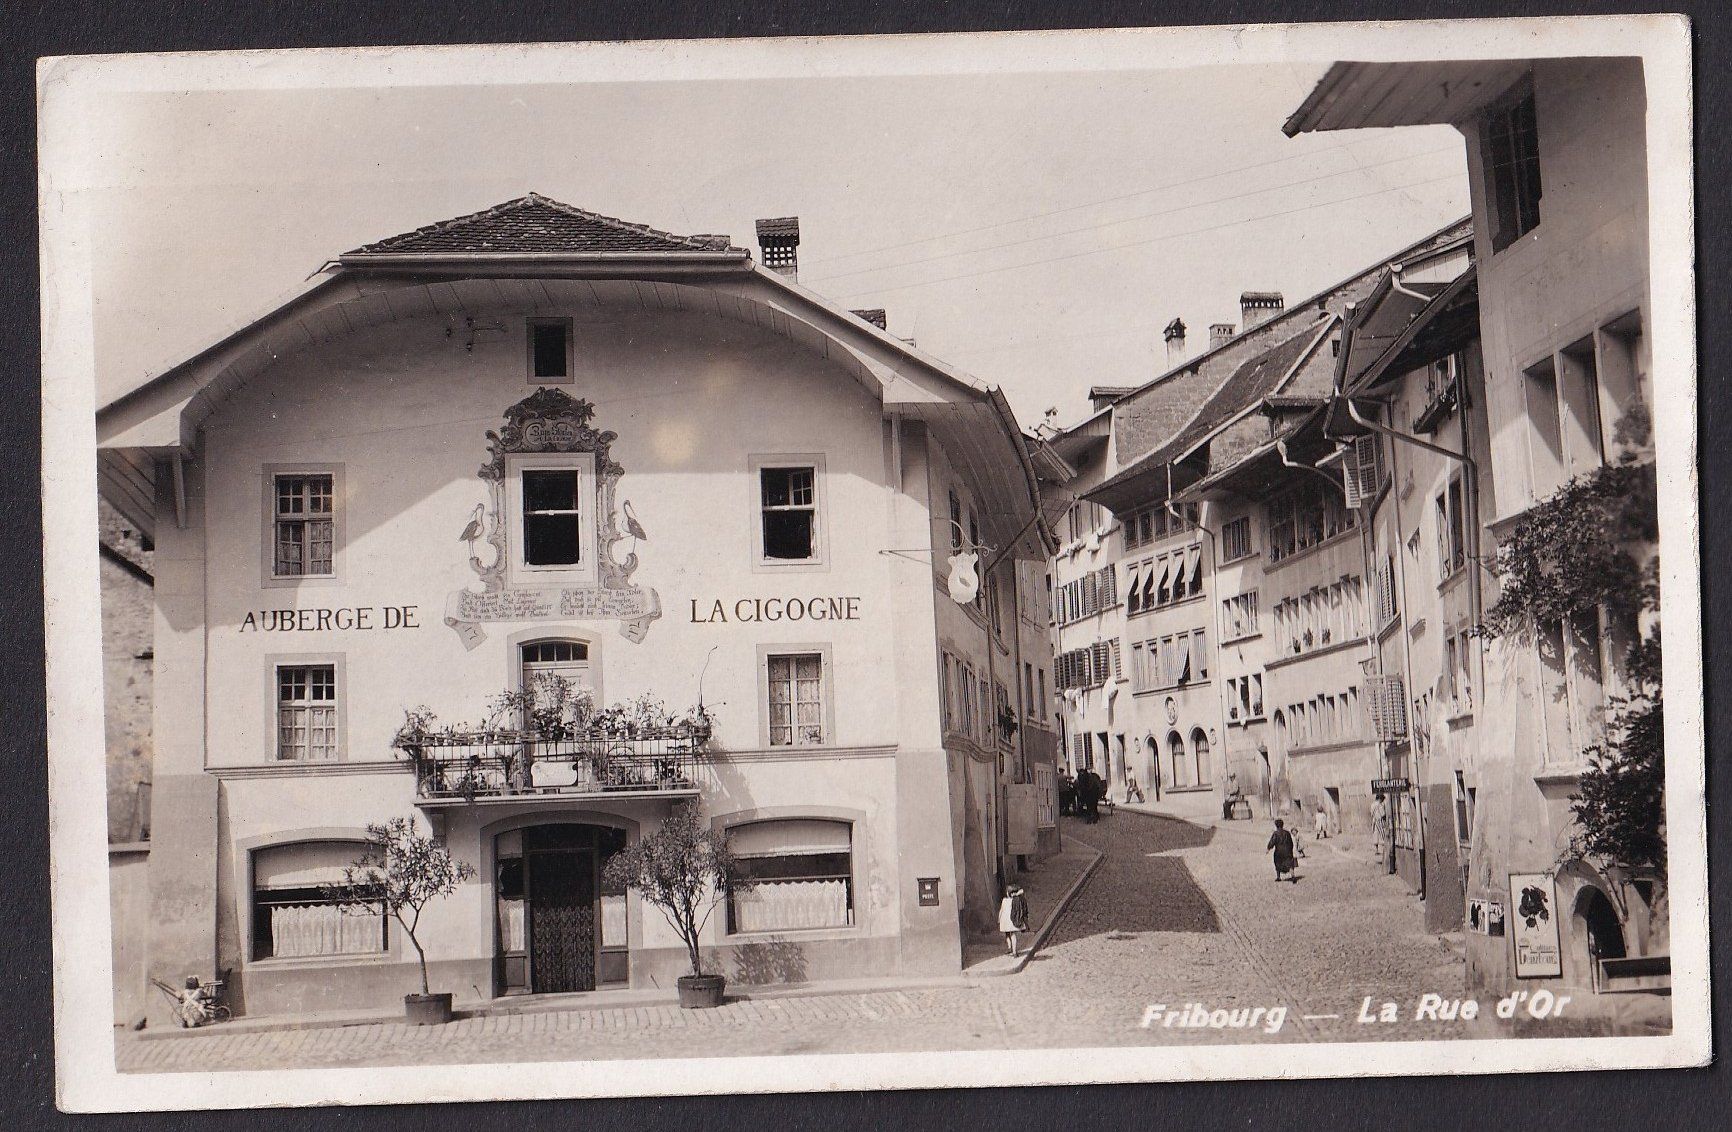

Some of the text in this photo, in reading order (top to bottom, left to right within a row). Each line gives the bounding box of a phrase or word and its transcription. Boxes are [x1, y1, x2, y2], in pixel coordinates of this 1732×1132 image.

[238, 596, 861, 633] AUBERGE DE LA CIGOGNE
